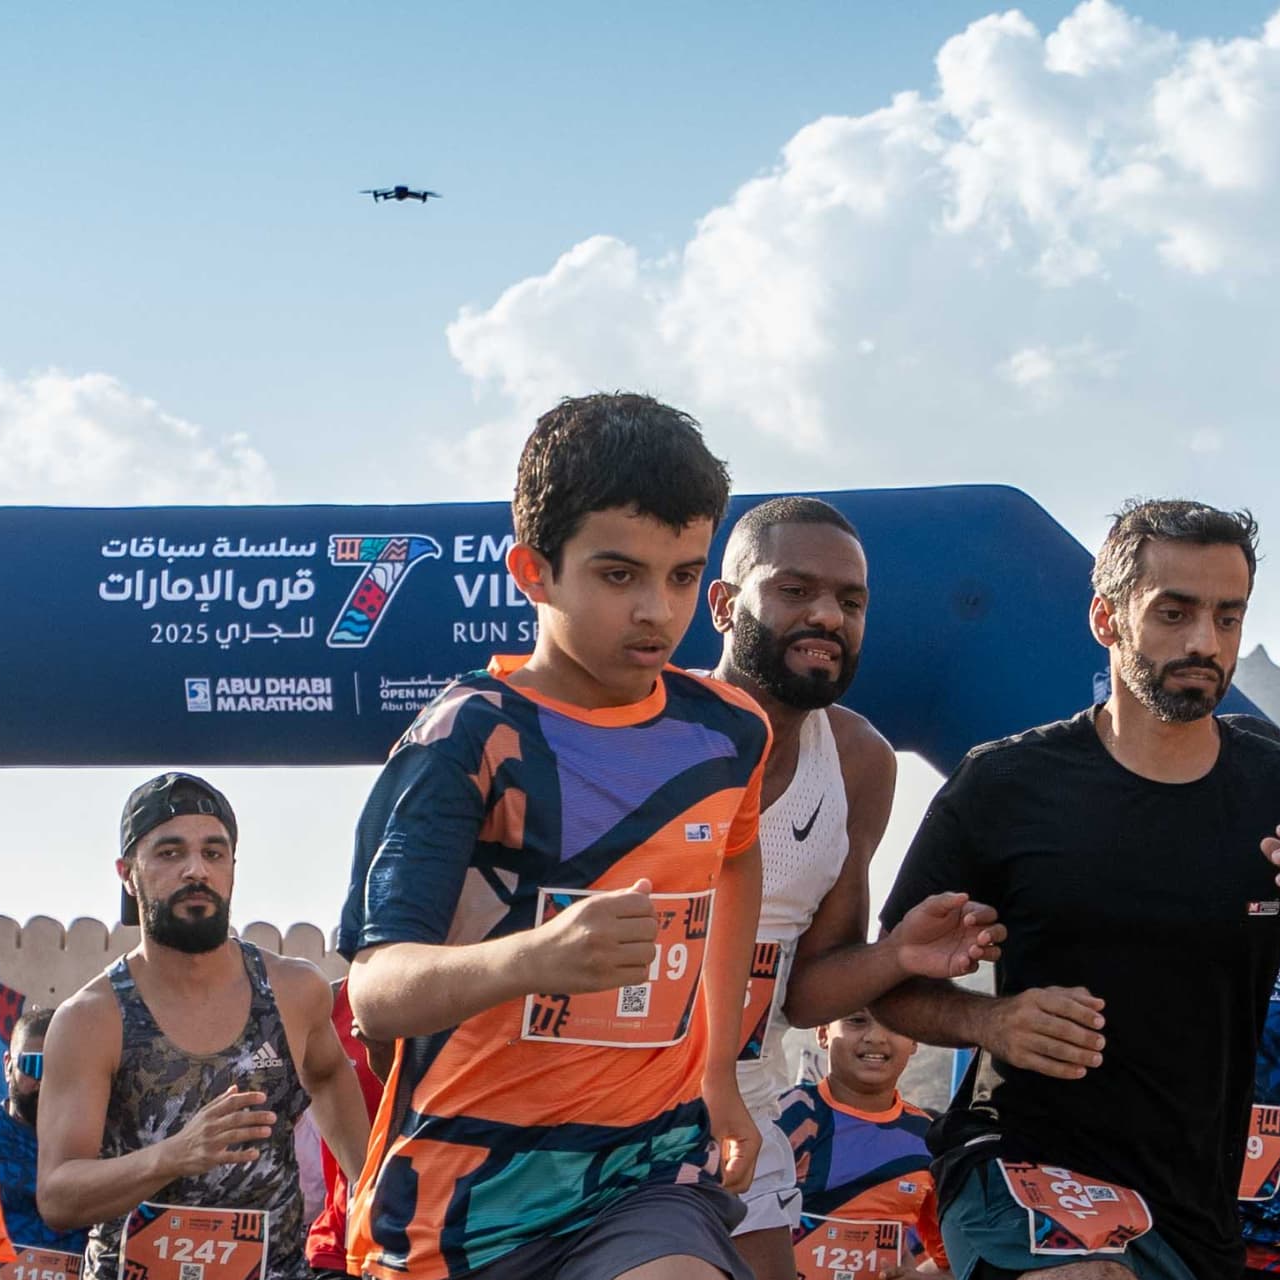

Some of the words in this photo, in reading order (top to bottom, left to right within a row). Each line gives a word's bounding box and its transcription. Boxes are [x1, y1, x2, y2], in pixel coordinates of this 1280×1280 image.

[101, 537, 206, 564] سباقات
[212, 537, 317, 558] سلسلة
[98, 569, 233, 612] الإمارات
[237, 568, 316, 610] قرى
[150, 623, 209, 644] 2025
[215, 617, 315, 649] للجري
[453, 621, 507, 643] RUN
[216, 678, 263, 695] ABU
[265, 678, 332, 695] DHABI
[380, 688, 415, 699] OPEN
[217, 697, 333, 712] MARATHON
[381, 702, 402, 711] Abu
[153, 1236, 238, 1265] 1247
[812, 1245, 877, 1272] 1231
